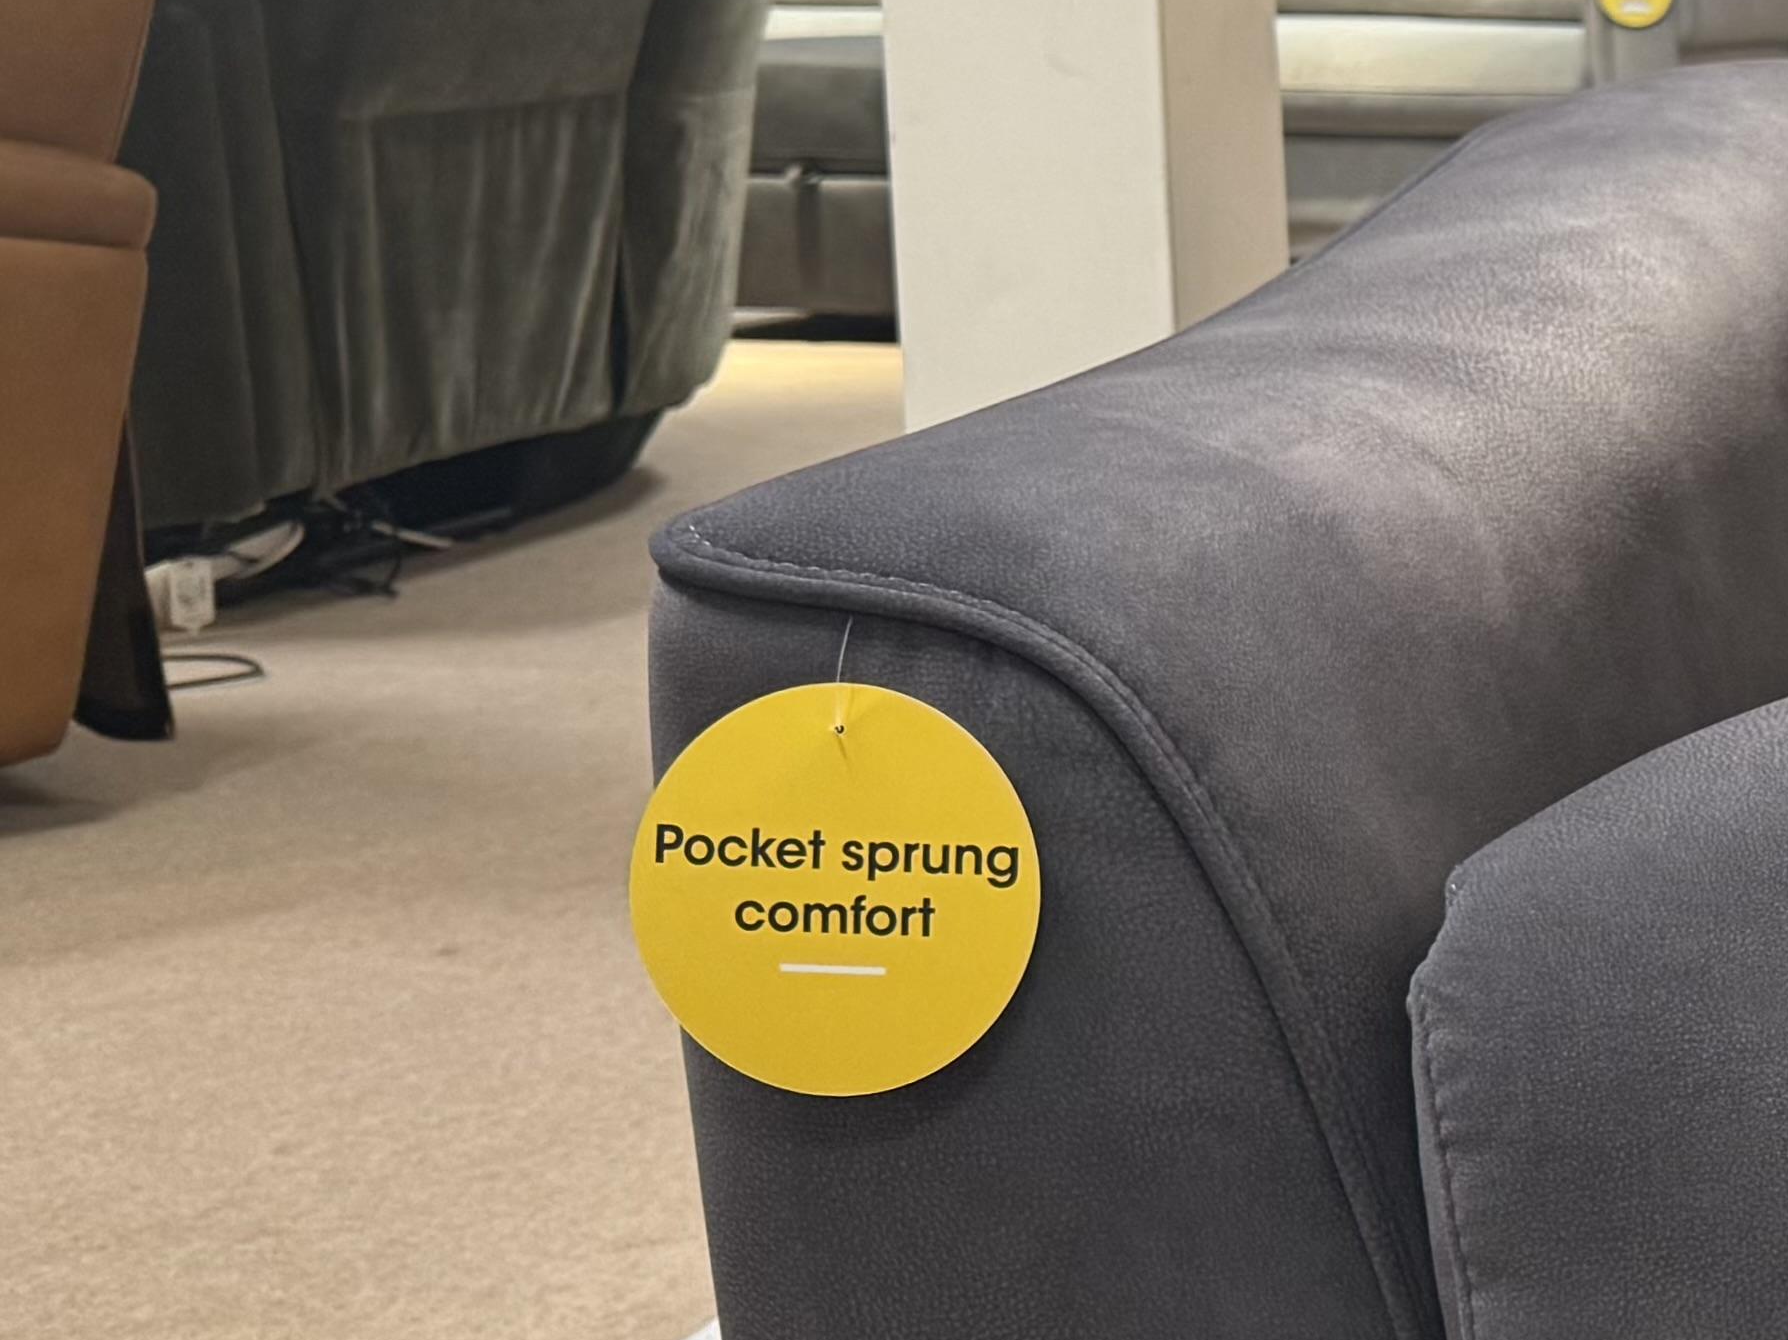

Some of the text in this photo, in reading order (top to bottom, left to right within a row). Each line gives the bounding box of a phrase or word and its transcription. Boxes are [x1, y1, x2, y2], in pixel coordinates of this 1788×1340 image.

[655, 823, 1020, 889] Pocket sprung
[734, 895, 937, 938] comfort
